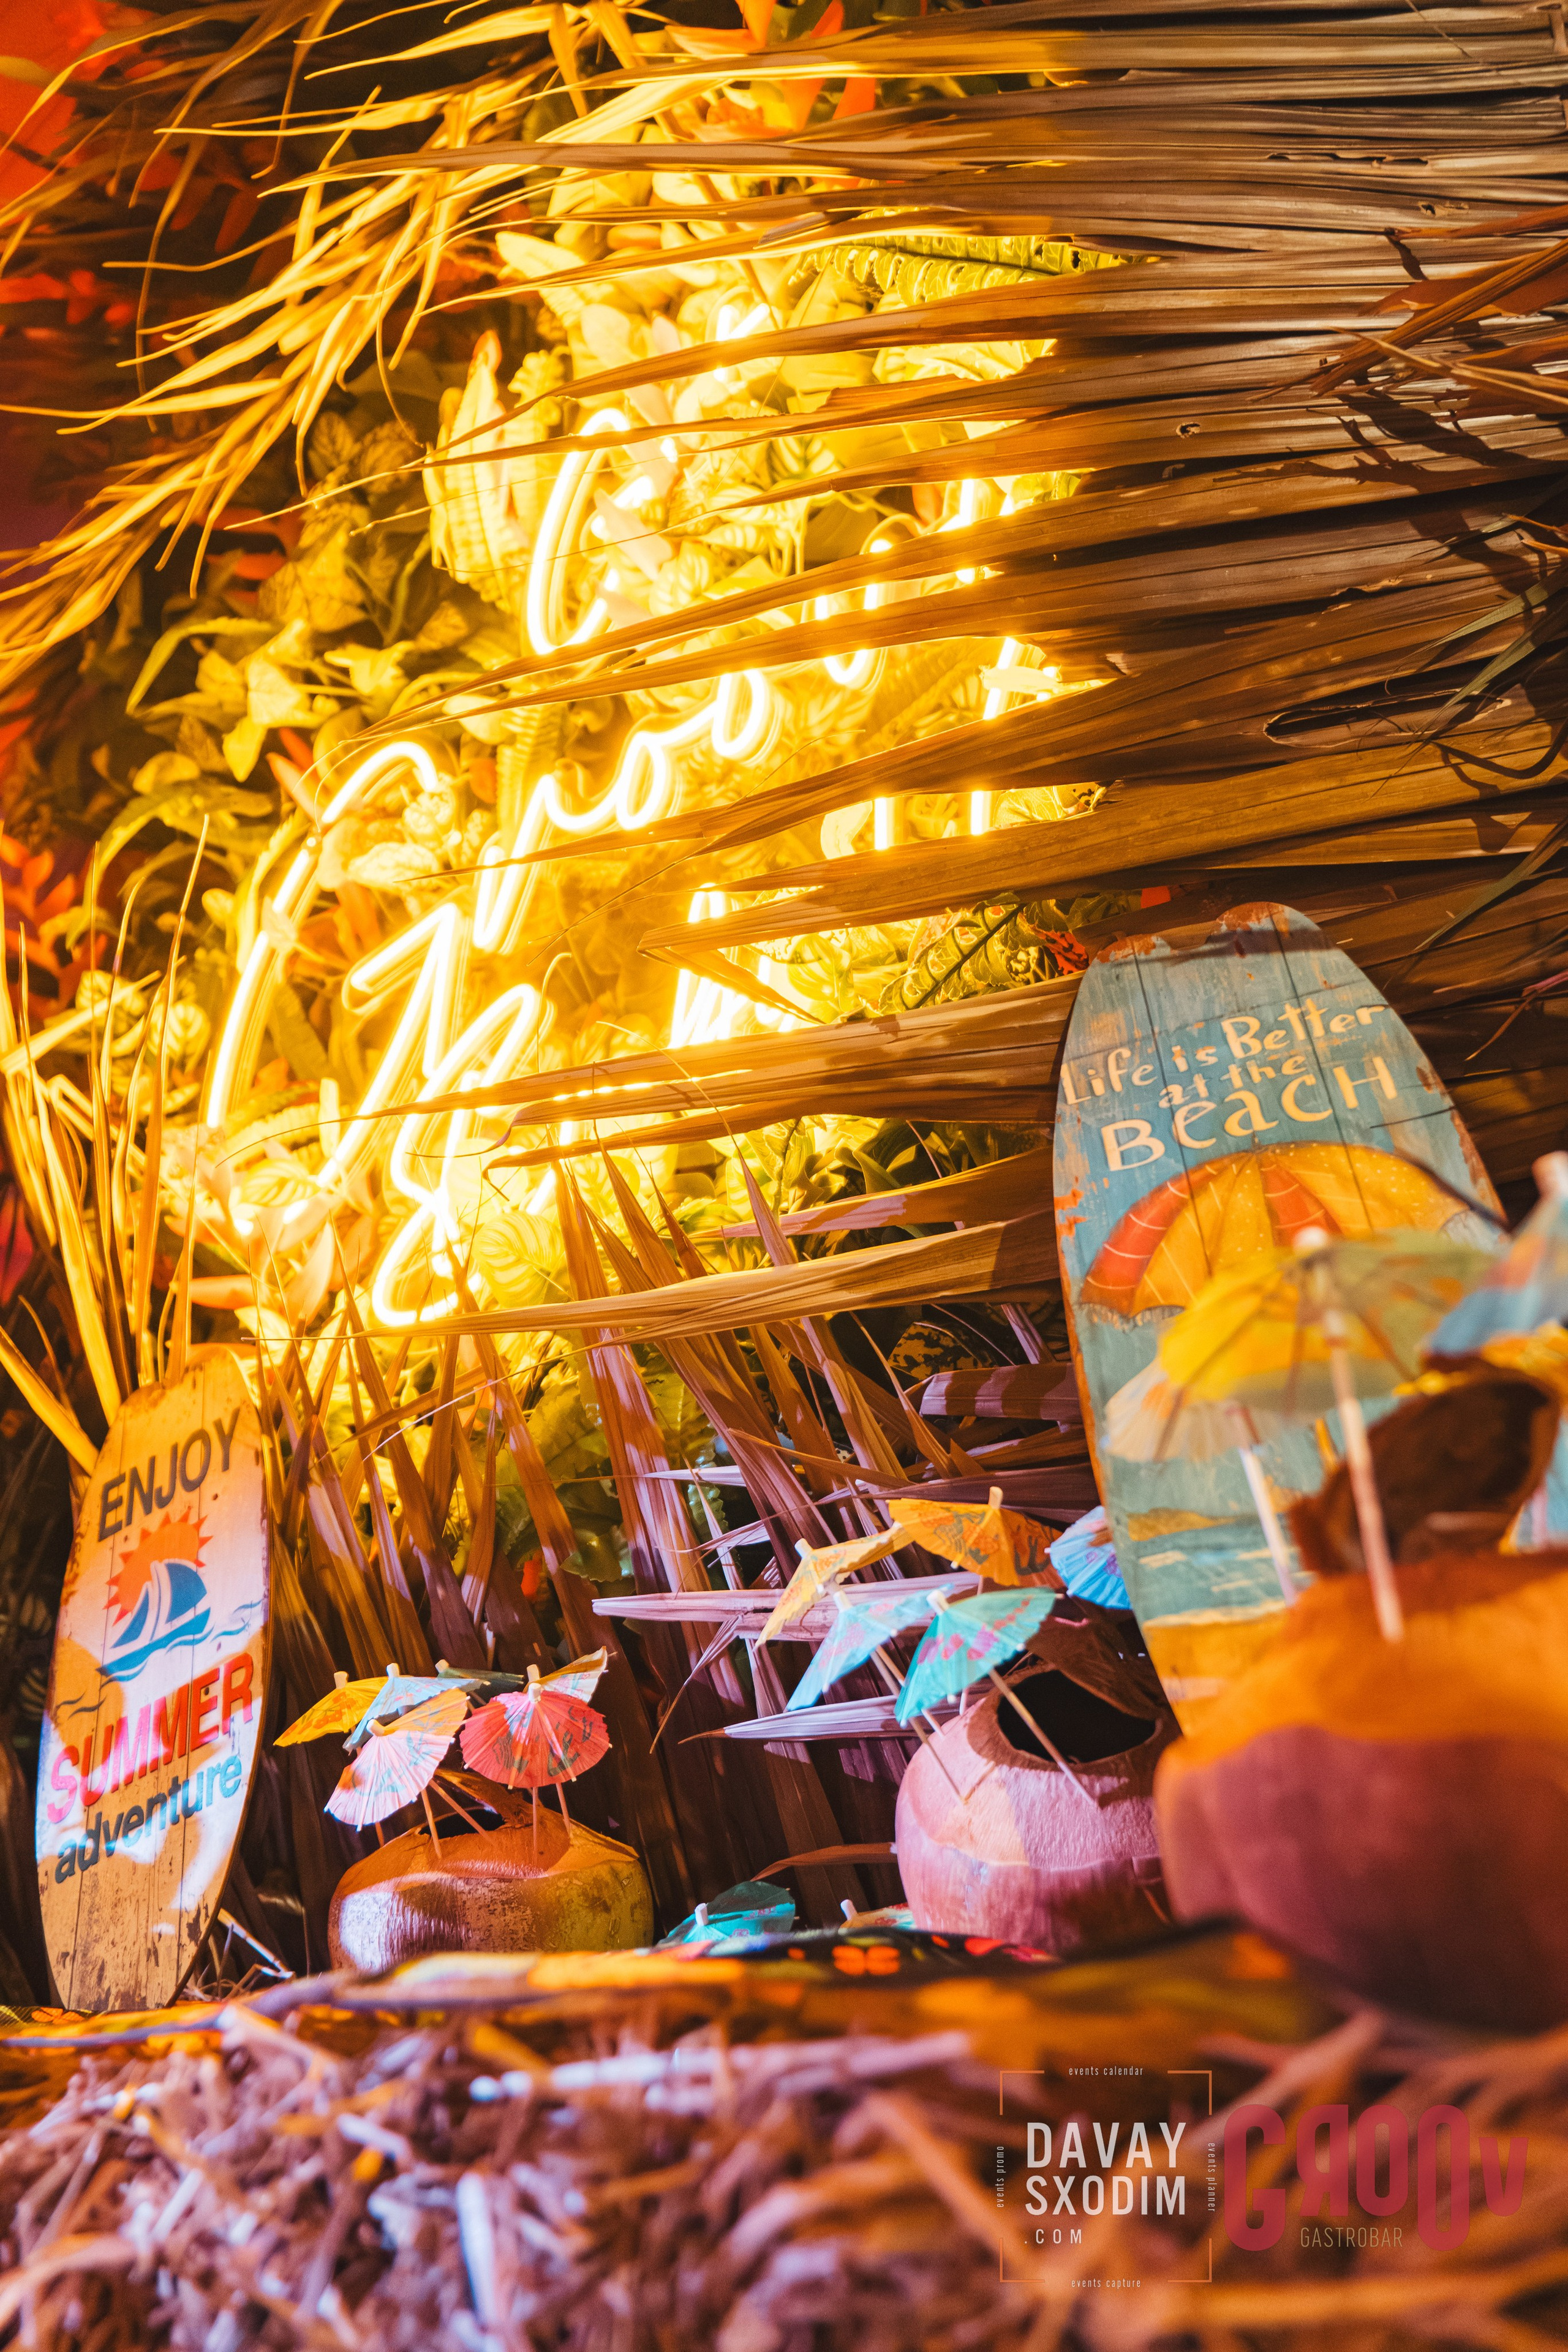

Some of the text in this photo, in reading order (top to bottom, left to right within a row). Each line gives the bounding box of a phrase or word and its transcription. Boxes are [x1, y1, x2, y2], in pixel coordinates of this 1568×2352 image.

[1060, 998, 1385, 1104] Life is Better
[1159, 1054, 1306, 1109] at the
[97, 1409, 240, 1542] ENJOY
[47, 1654, 254, 1824] SUMMER
[54, 1753, 242, 1884] adventure
